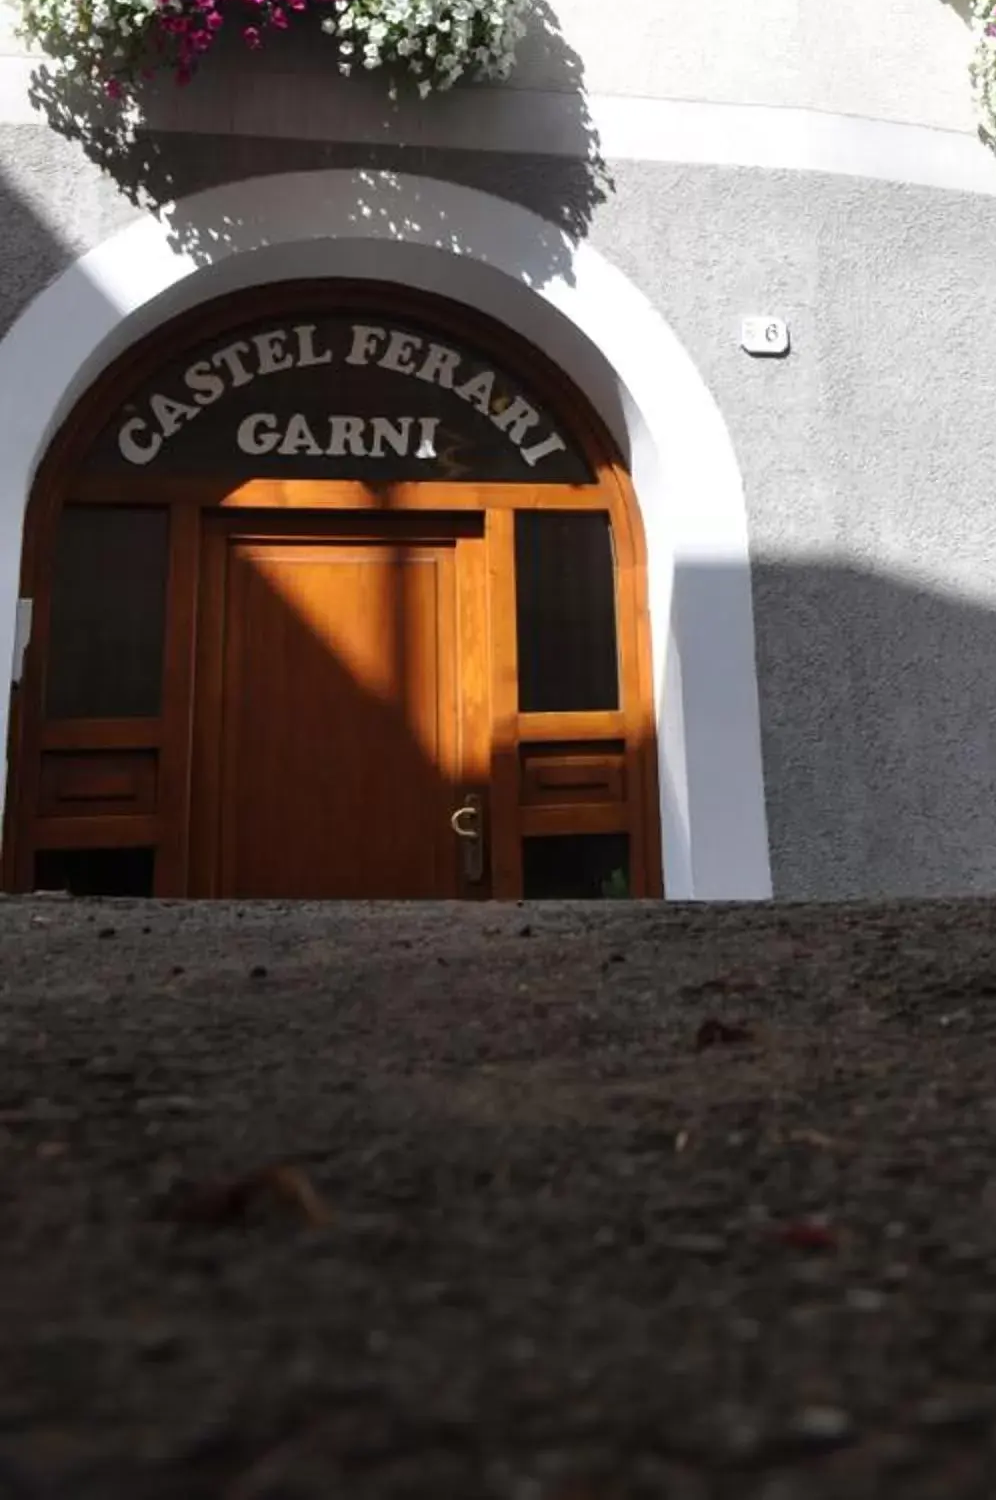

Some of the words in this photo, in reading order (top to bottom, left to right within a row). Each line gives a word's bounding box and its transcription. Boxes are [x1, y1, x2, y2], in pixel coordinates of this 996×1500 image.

[765, 323, 779, 342] 6
[118, 325, 332, 465] CASTEL
[345, 325, 567, 467] FERARI
[236, 413, 440, 459] GARNI
